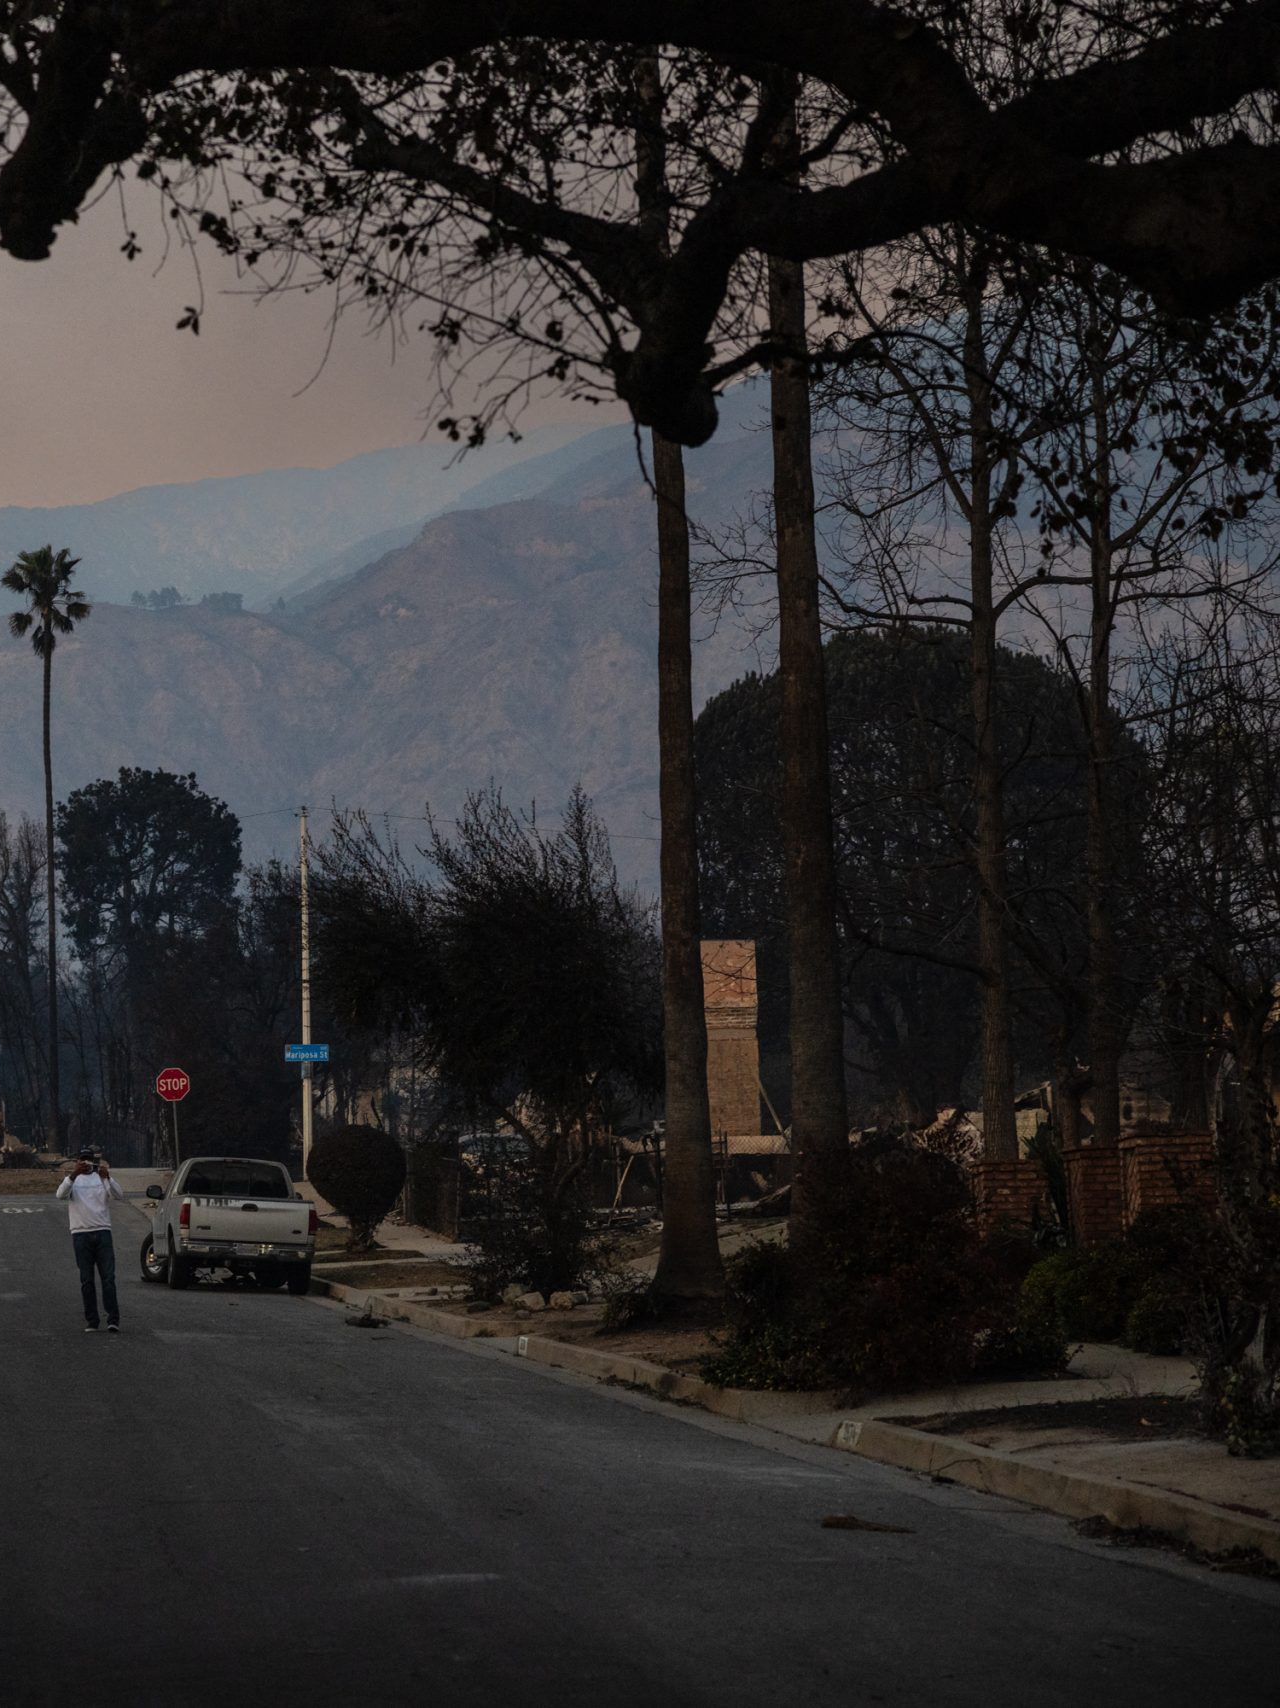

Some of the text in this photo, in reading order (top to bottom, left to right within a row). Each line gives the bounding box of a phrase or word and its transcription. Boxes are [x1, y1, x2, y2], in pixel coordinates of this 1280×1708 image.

[285, 1051, 328, 1060] Mariposa St
[159, 1077, 187, 1092] STOP
